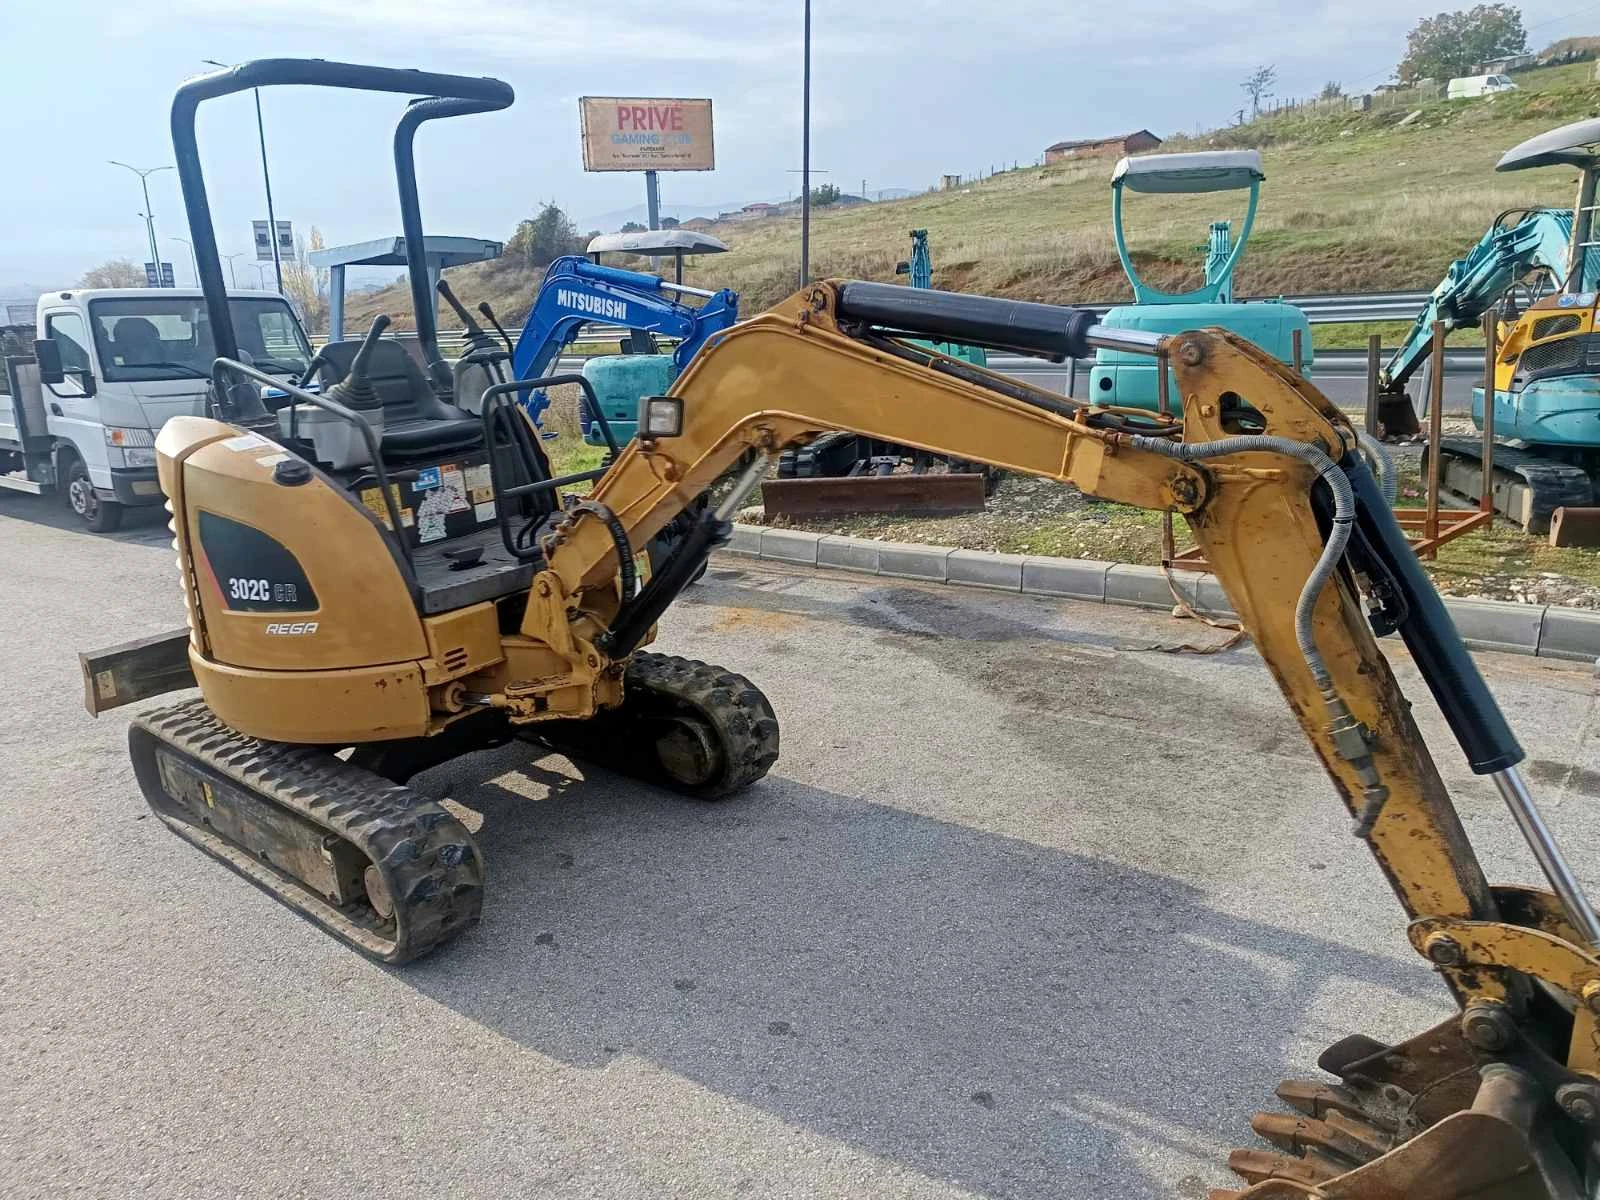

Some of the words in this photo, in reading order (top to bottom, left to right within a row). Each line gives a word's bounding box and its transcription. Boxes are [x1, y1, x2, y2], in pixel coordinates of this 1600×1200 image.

[557, 289, 627, 320] MITSUBISHI
[229, 578, 270, 602] 302C
[274, 583, 297, 602] CR
[265, 622, 319, 635] REGA
